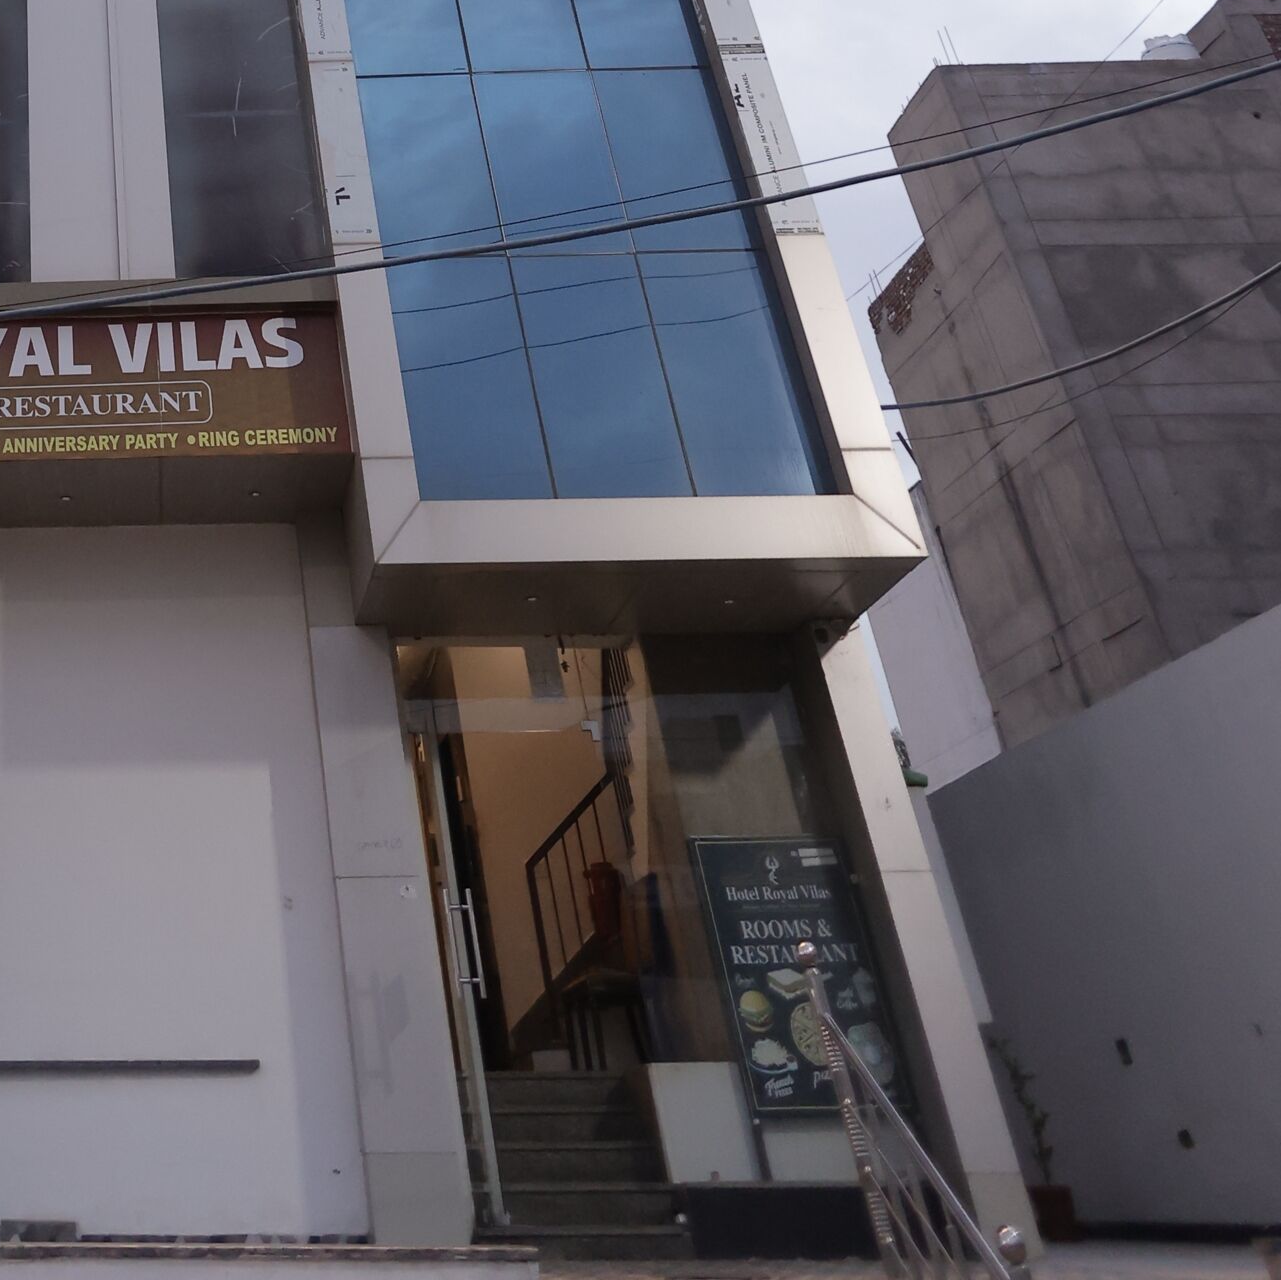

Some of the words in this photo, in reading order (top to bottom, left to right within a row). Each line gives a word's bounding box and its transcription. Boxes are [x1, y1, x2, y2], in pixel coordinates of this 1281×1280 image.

[742, 72, 753, 93] PANEL
[748, 92, 765, 134] COMPOSITE
[107, 317, 305, 374] VILAS
[3, 435, 121, 454] ANNIVERSARY
[125, 433, 178, 450] PARTY
[198, 430, 241, 448] RING
[244, 427, 337, 446] CEREMONY
[725, 885, 759, 901] Hotel
[763, 886, 799, 903] Royal
[799, 884, 832, 900] Vilas
[739, 919, 813, 940] ROOMS
[817, 918, 833, 938] &
